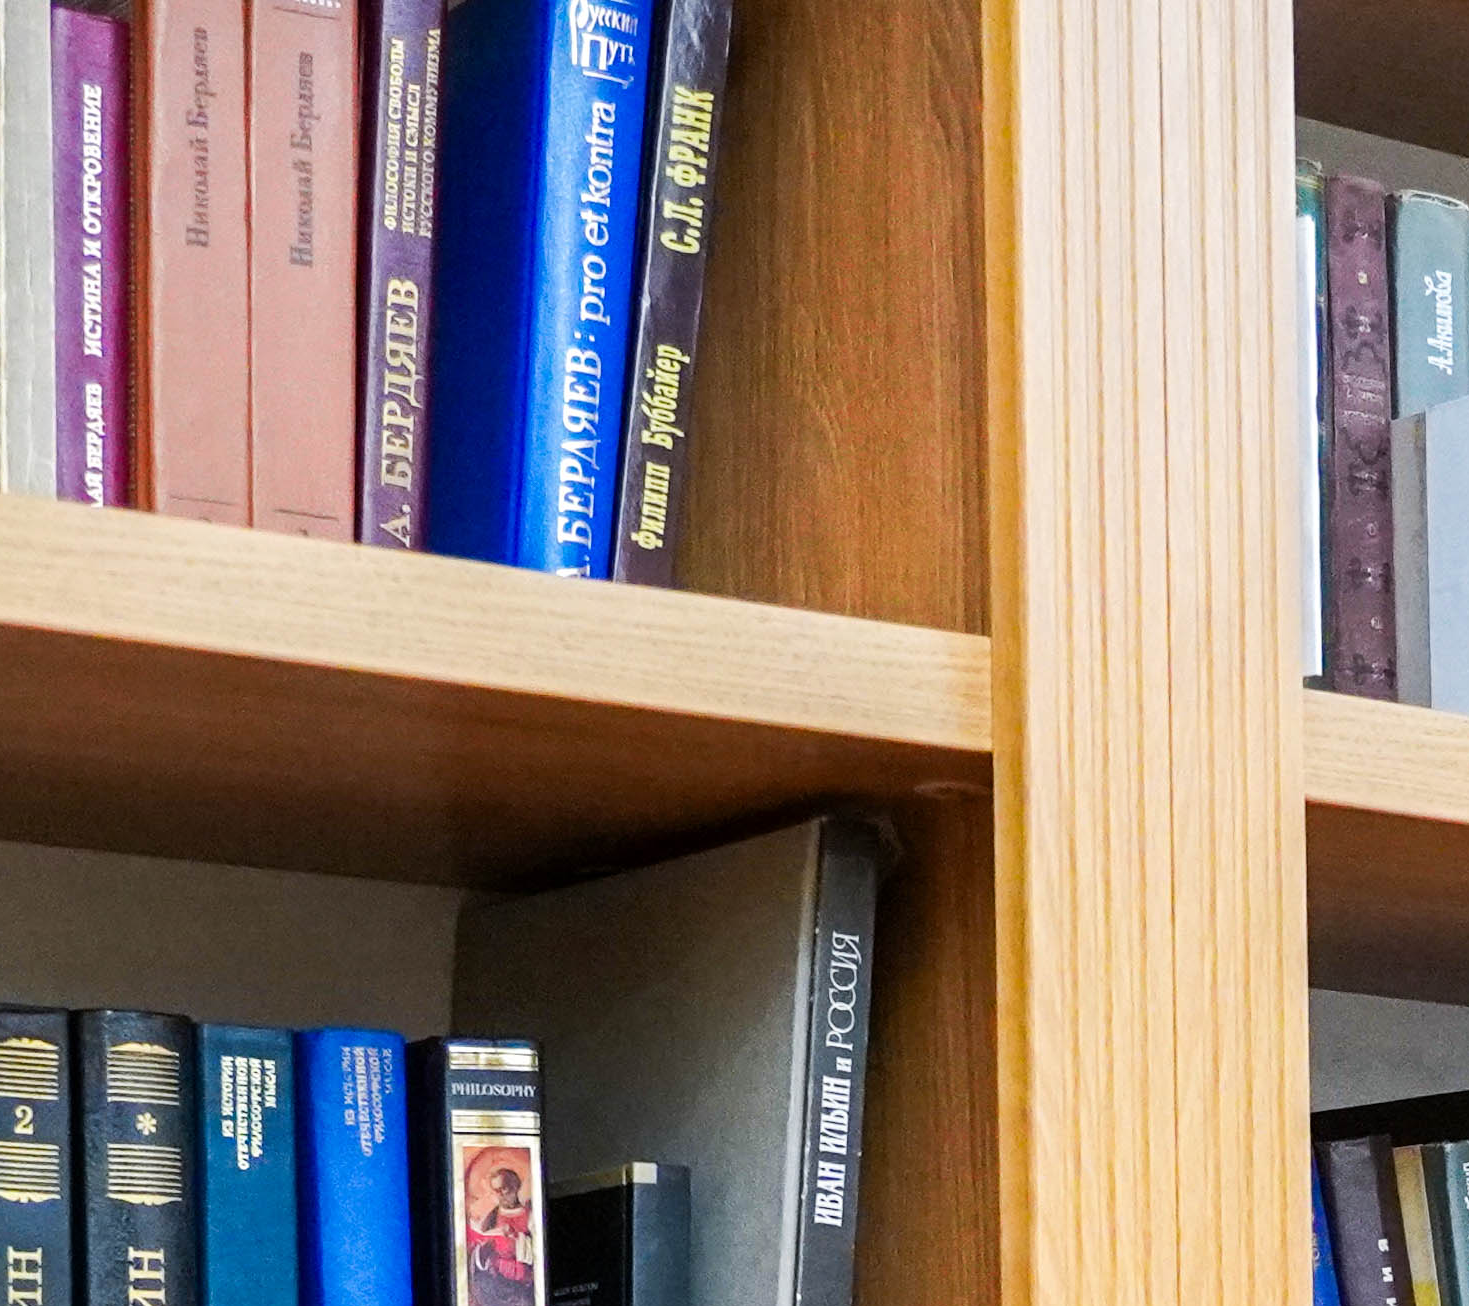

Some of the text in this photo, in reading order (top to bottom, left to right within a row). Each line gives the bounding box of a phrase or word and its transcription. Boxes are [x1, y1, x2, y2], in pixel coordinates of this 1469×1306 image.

[82, 84, 102, 358] ИСТИНА ОТКРОВЕНИЕ
[186, 25, 223, 249] Николай Бердяев
[290, 51, 322, 269] Николай Бердяев
[384, 39, 405, 230] ФИЛОСОФИЯ СВОБОДЫ
[660, 84, 715, 255] С.Л. ФРАНК
[379, 277, 420, 491] БЕРДЯЕВ
[561, 101, 617, 547] БЕРДЯЕВ pro et kontra
[1427, 269, 1454, 375] А.Акимова
[629, 345, 692, 551] Филипп Буббайер
[14, 1105, 34, 1135] 2
[451, 1083, 537, 1100] PHILOSOPHY
[812, 931, 861, 1228] ИВАН ИЛЬИН РОССИЯ
